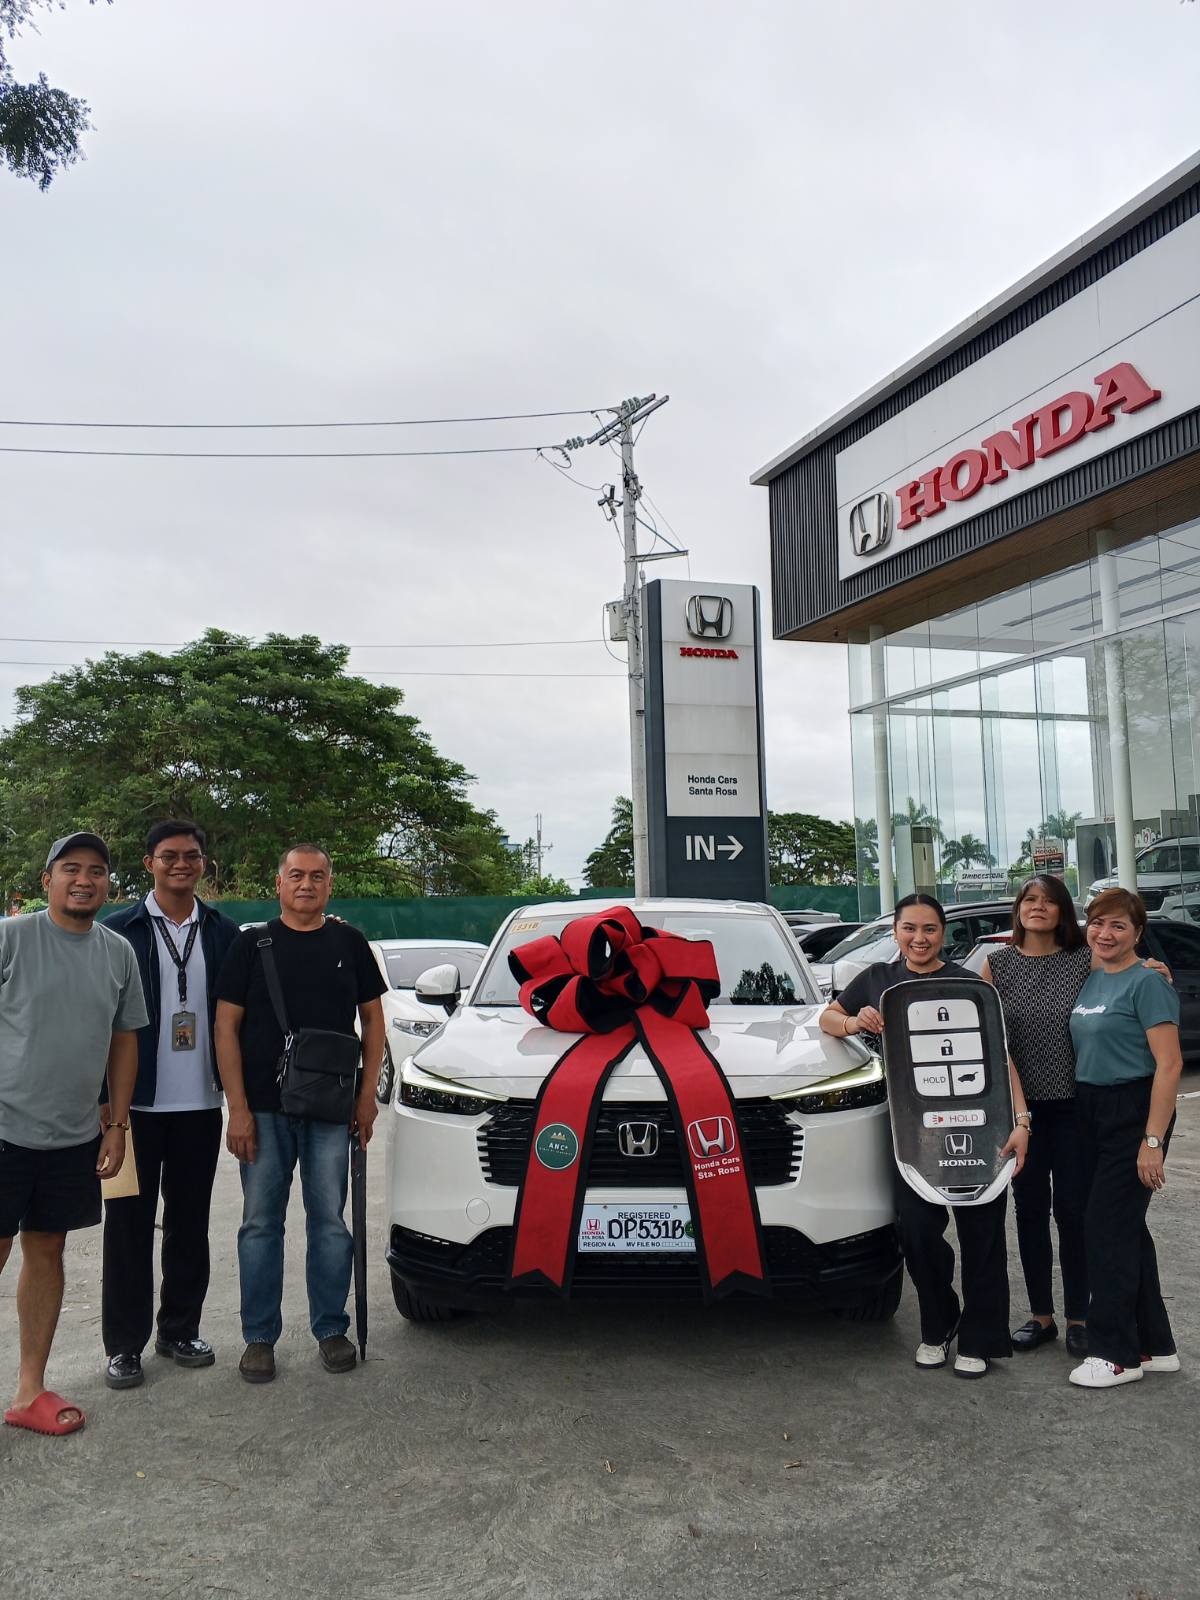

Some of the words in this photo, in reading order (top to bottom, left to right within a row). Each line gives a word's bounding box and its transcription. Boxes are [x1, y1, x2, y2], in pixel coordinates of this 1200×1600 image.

[896, 362, 1162, 530] HONDA
[679, 647, 739, 659] HONDA
[687, 774, 716, 784] Honda
[717, 775, 738, 784] Cars
[688, 786, 714, 796] Santa
[715, 787, 738, 796] Rosa
[686, 835, 716, 861] IN
[922, 1076, 946, 1084] HOLD
[949, 1114, 979, 1123] HOLD
[694, 1160, 720, 1171] Honda
[721, 1156, 741, 1165] Cars
[938, 1159, 987, 1167] HONDA
[697, 1171, 716, 1180] Sta.
[717, 1166, 741, 1176] Rosa
[617, 1211, 671, 1219] REGISTERED
[607, 1218, 685, 1239] DP531B
